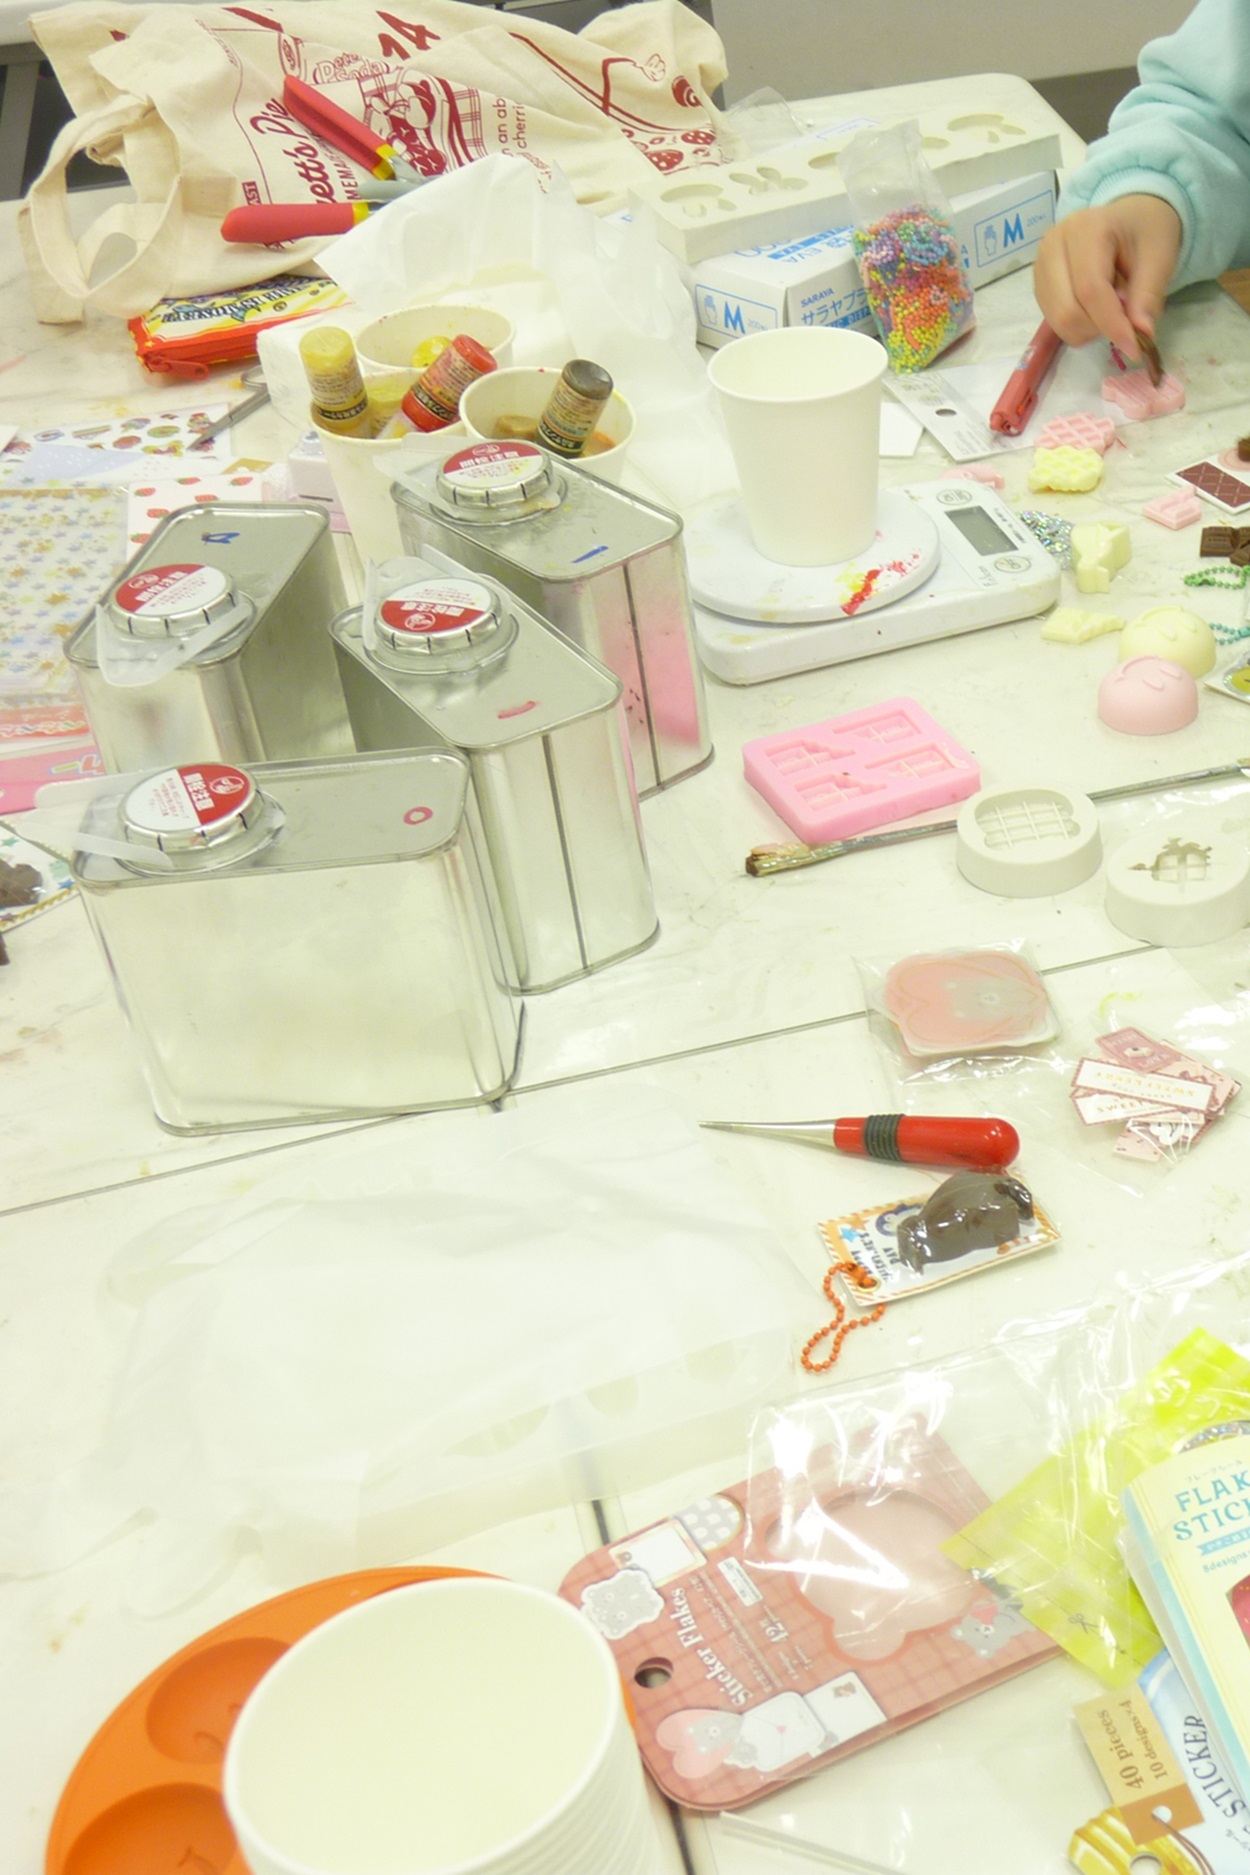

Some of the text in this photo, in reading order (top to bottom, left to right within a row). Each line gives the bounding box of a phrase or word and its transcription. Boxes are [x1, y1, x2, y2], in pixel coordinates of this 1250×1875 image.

[1003, 213, 1024, 248] M
[800, 287, 834, 308] SARAYA
[723, 304, 746, 334] M
[669, 1587, 705, 1648] Flakes
[763, 1622, 790, 1644] 42
[696, 1646, 754, 1708] Sticker
[1093, 1708, 1147, 1794] 40 pieces
[1183, 1715, 1247, 1818] STICKER
[1149, 1759, 1169, 1781] 10
